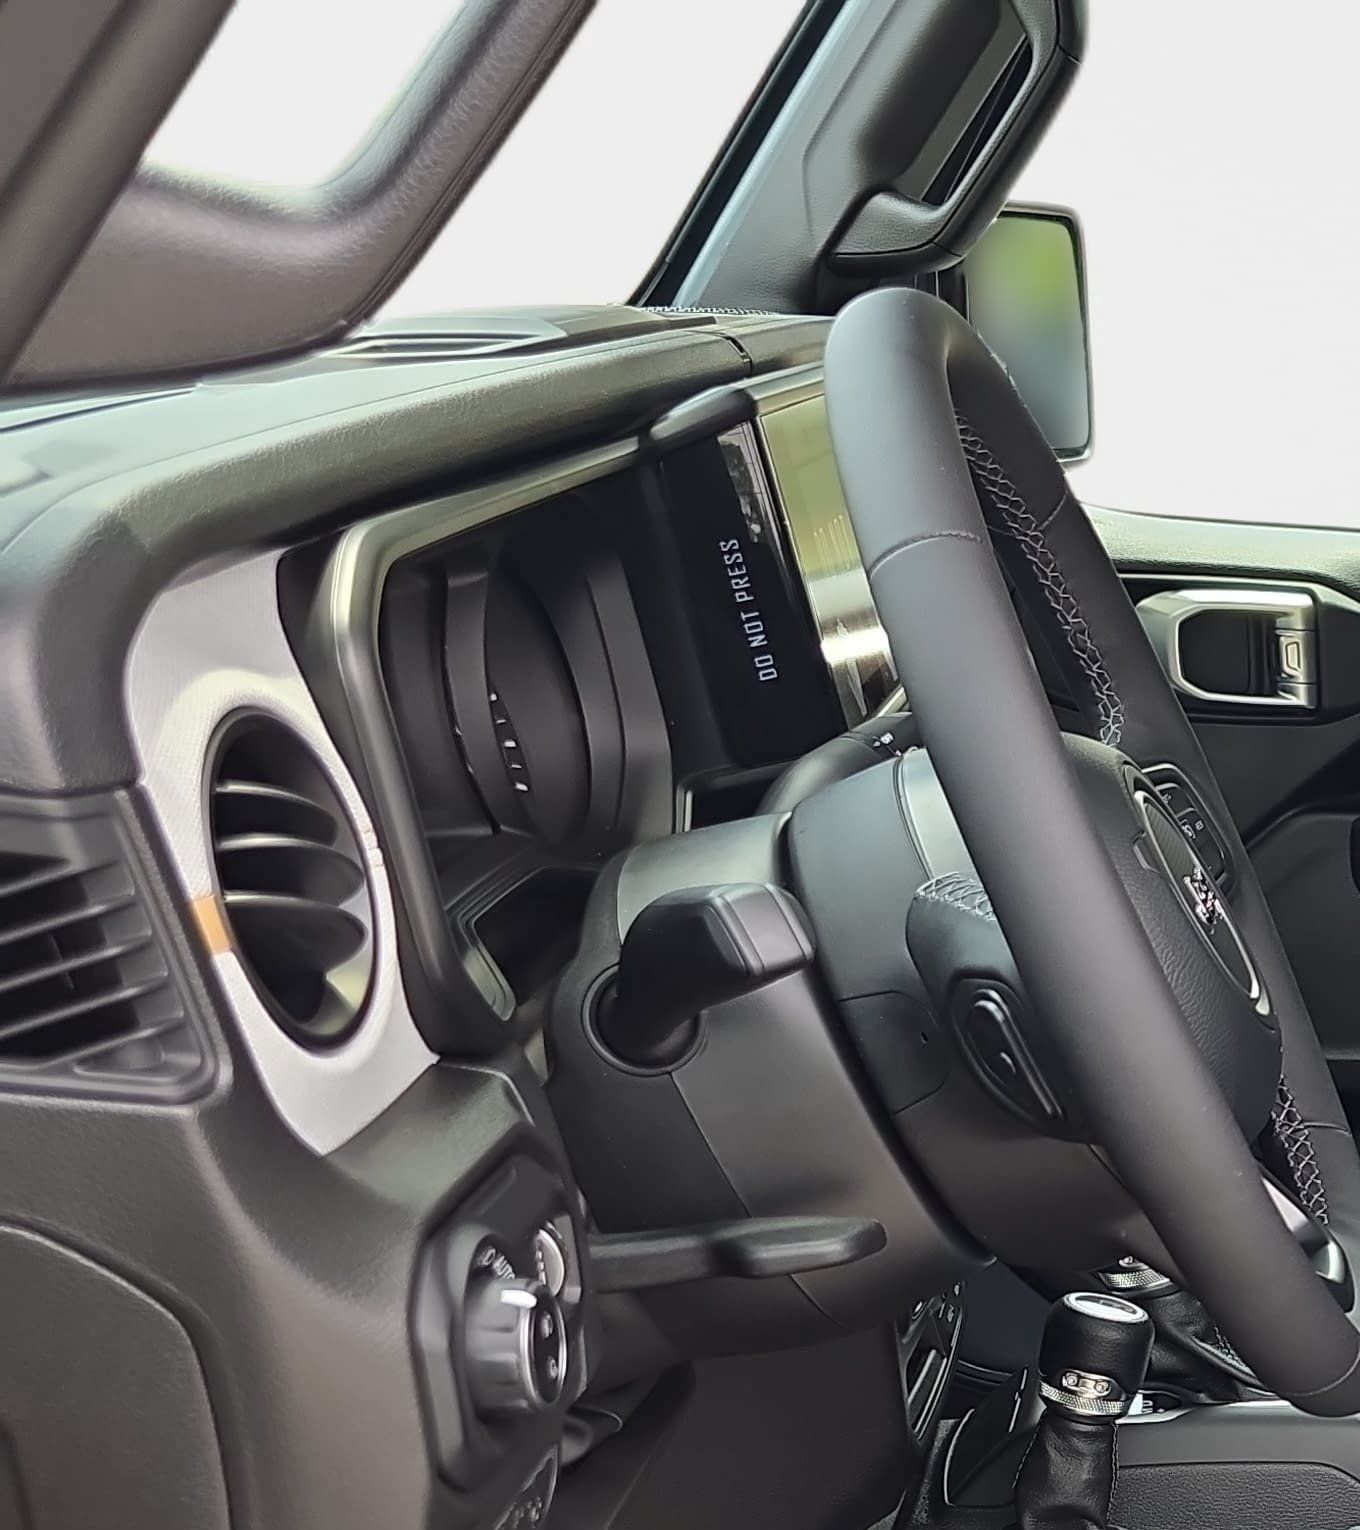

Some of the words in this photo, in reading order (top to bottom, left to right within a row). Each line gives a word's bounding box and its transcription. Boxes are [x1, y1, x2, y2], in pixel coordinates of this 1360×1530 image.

[720, 539, 753, 602] PRESS
[740, 611, 767, 647] NOT
[754, 654, 777, 680] DO
